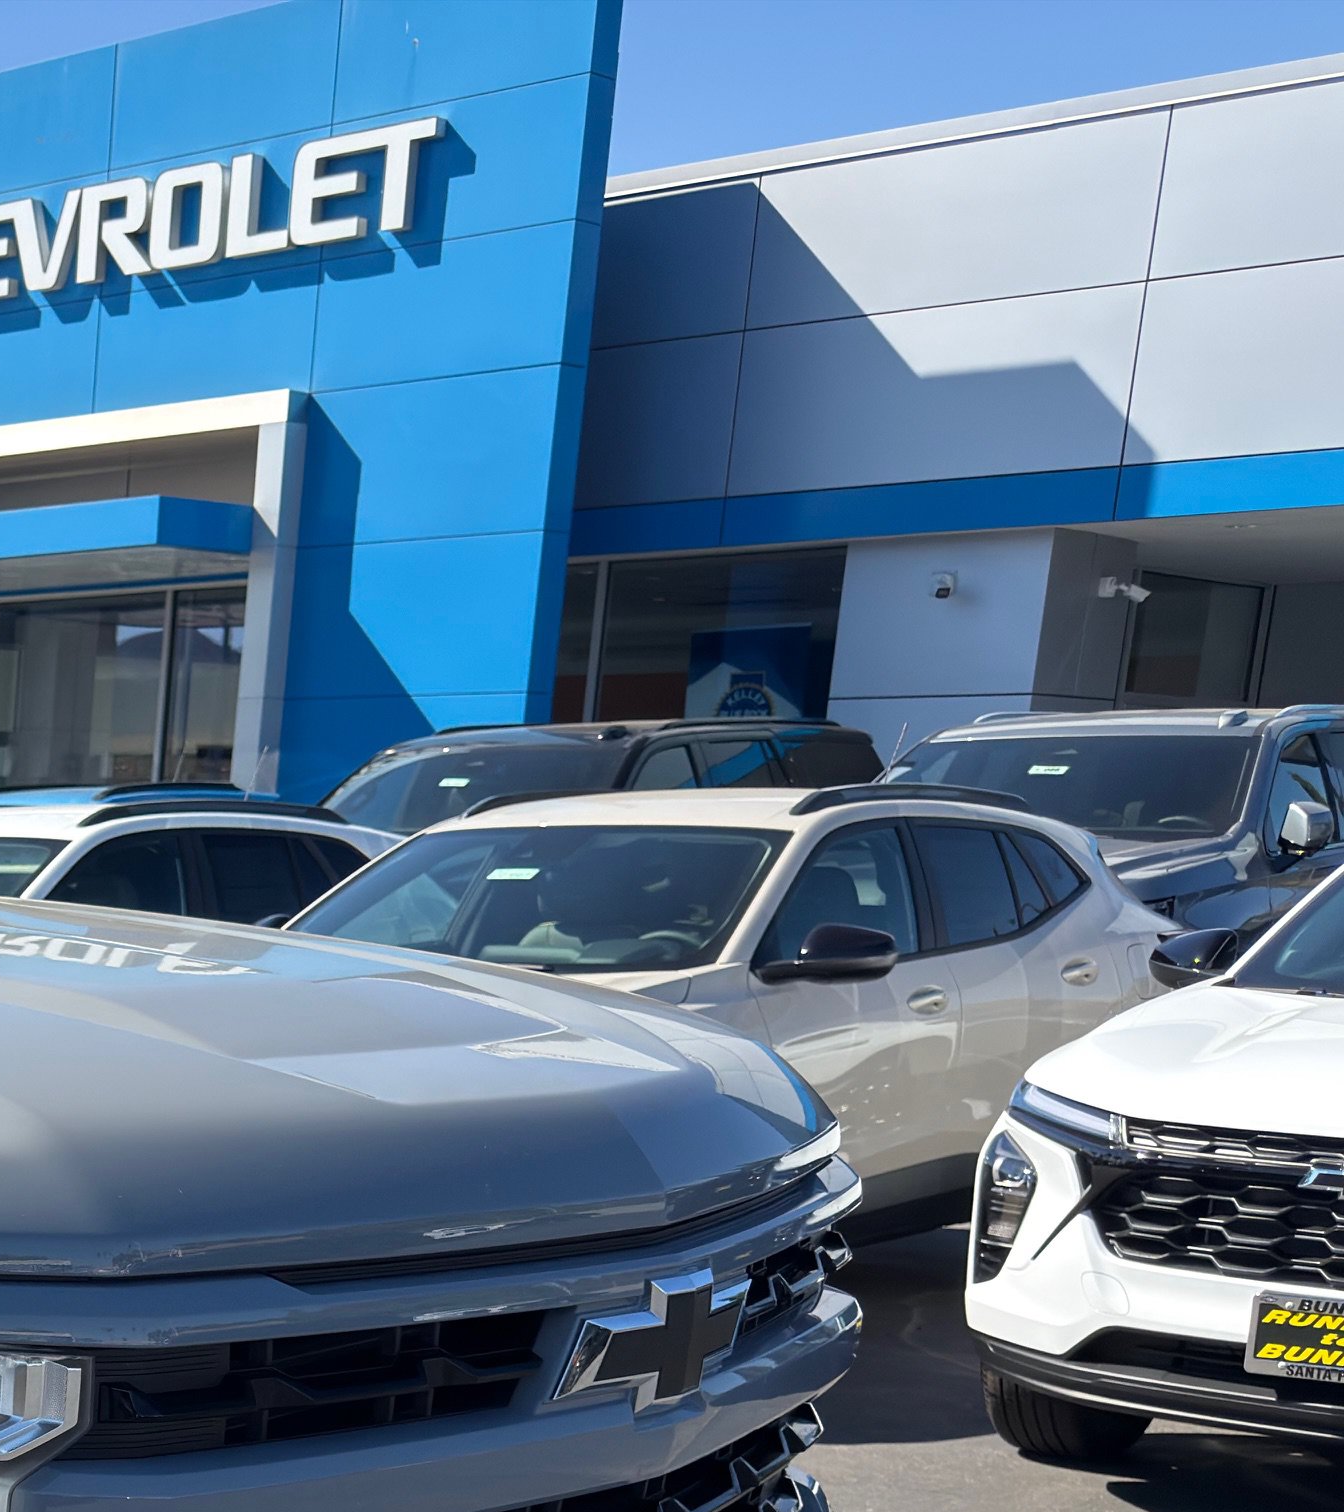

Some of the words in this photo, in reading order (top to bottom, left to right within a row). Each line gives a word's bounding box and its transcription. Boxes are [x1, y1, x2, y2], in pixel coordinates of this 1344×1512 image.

[1262, 1310, 1344, 1331] RUN
[1256, 1343, 1344, 1367] BUN
[1286, 1365, 1332, 1381] SANTA
